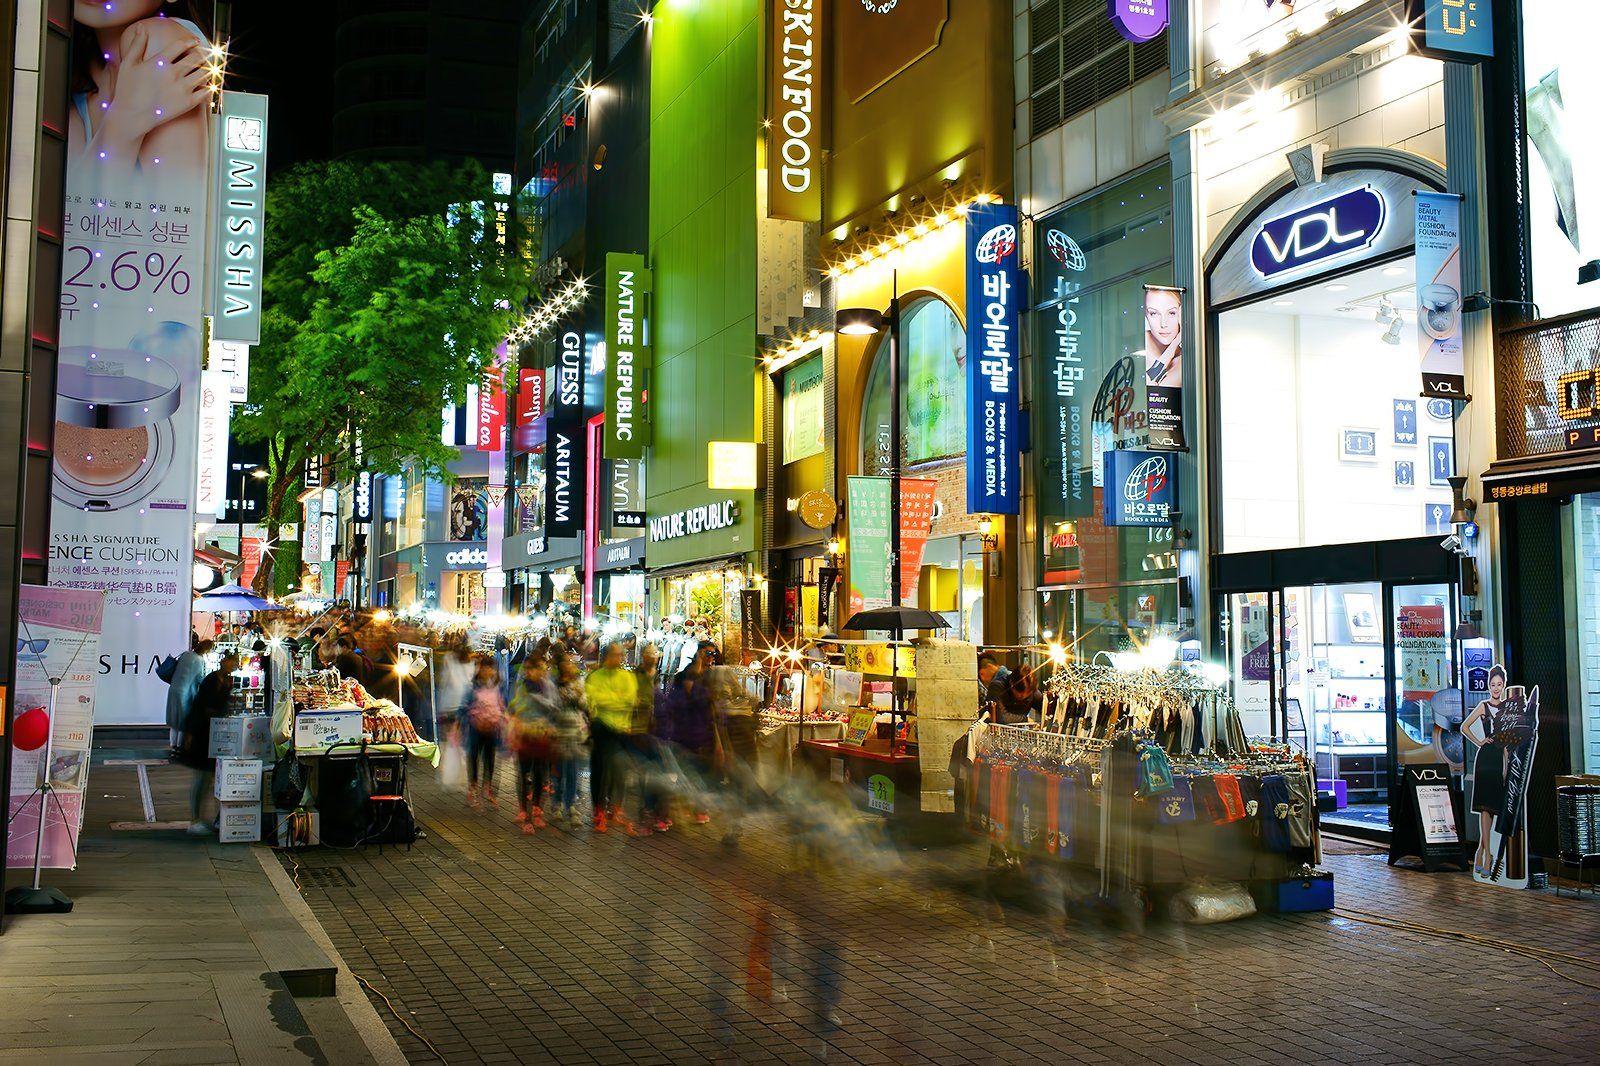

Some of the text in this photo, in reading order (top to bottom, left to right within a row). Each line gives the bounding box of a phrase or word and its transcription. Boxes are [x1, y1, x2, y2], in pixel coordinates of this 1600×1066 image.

[1418, 207, 1441, 215] BEAUTY
[1418, 214, 1438, 222] METAL
[80, 215, 143, 239] 에센스
[149, 221, 190, 245] 성분
[1418, 221, 1446, 230] CUSHION
[1418, 228, 1457, 238] FOUNDATION
[225, 160, 255, 316] MISSHA
[1261, 206, 1365, 263] VDL
[64, 245, 190, 295] 2.6%
[981, 270, 1013, 394] 바오로딸
[616, 270, 634, 441] NATURE REPUBLIC
[561, 331, 580, 406] GUESS
[1429, 381, 1459, 393] VDL
[985, 400, 996, 497] BOOKS & MEDIA
[1155, 437, 1181, 447] VDL
[555, 433, 571, 523] ARITAUM
[1124, 502, 1170, 518] 바오로딸
[650, 499, 734, 543] NATURE REPUBLIC
[93, 535, 160, 545] SIGNATURE
[526, 539, 546, 556] GUESS
[98, 546, 179, 562] CUSHION
[72, 566, 100, 576] 에센스
[101, 566, 120, 576] 쿠션
[1465, 651, 1491, 663] VDL
[1474, 679, 1485, 690] 30
[1411, 769, 1447, 780] VDL
